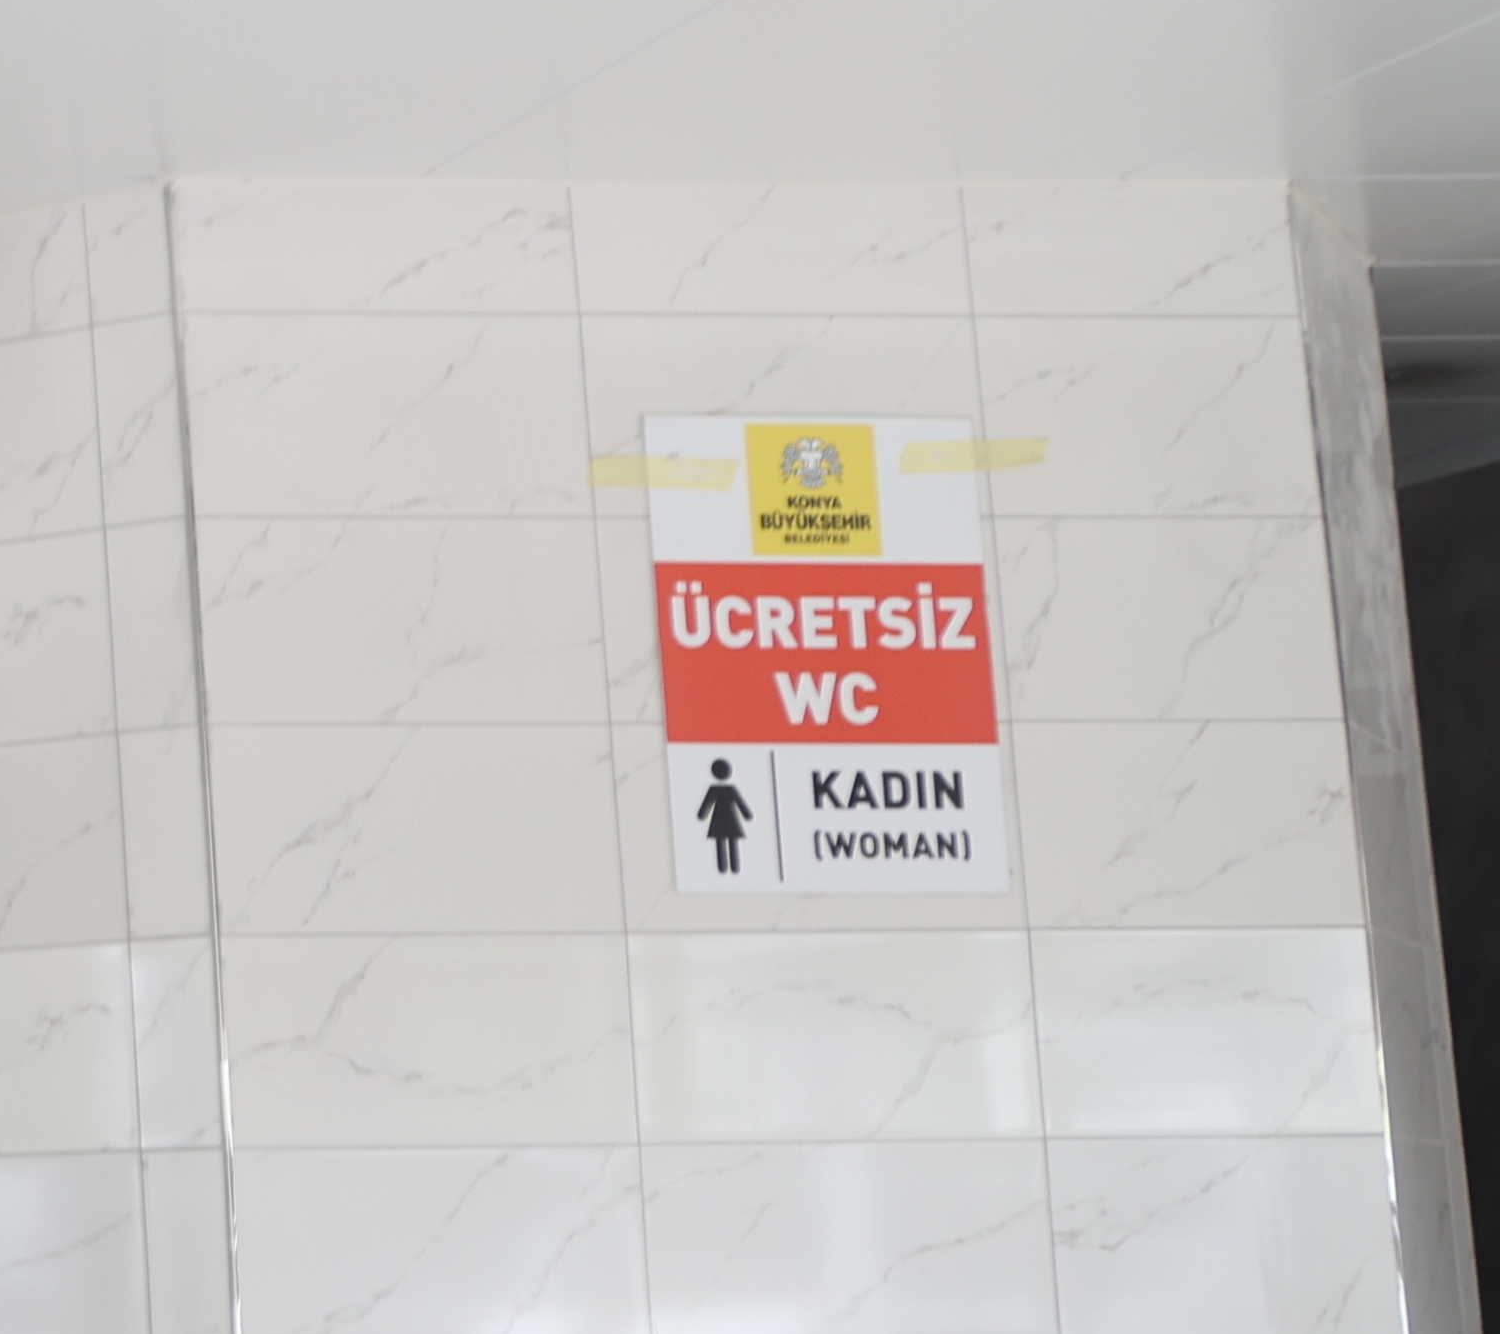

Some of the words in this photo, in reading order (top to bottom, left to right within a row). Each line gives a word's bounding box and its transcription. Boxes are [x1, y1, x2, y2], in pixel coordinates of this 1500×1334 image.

[760, 511, 871, 530] BÜYÜKŞEHİR
[788, 496, 842, 509] KONYA
[669, 581, 977, 651] ÜCRETSİZ
[774, 671, 880, 726] WC
[811, 771, 966, 811] KADIN
[813, 830, 972, 862] (WOMAN)
